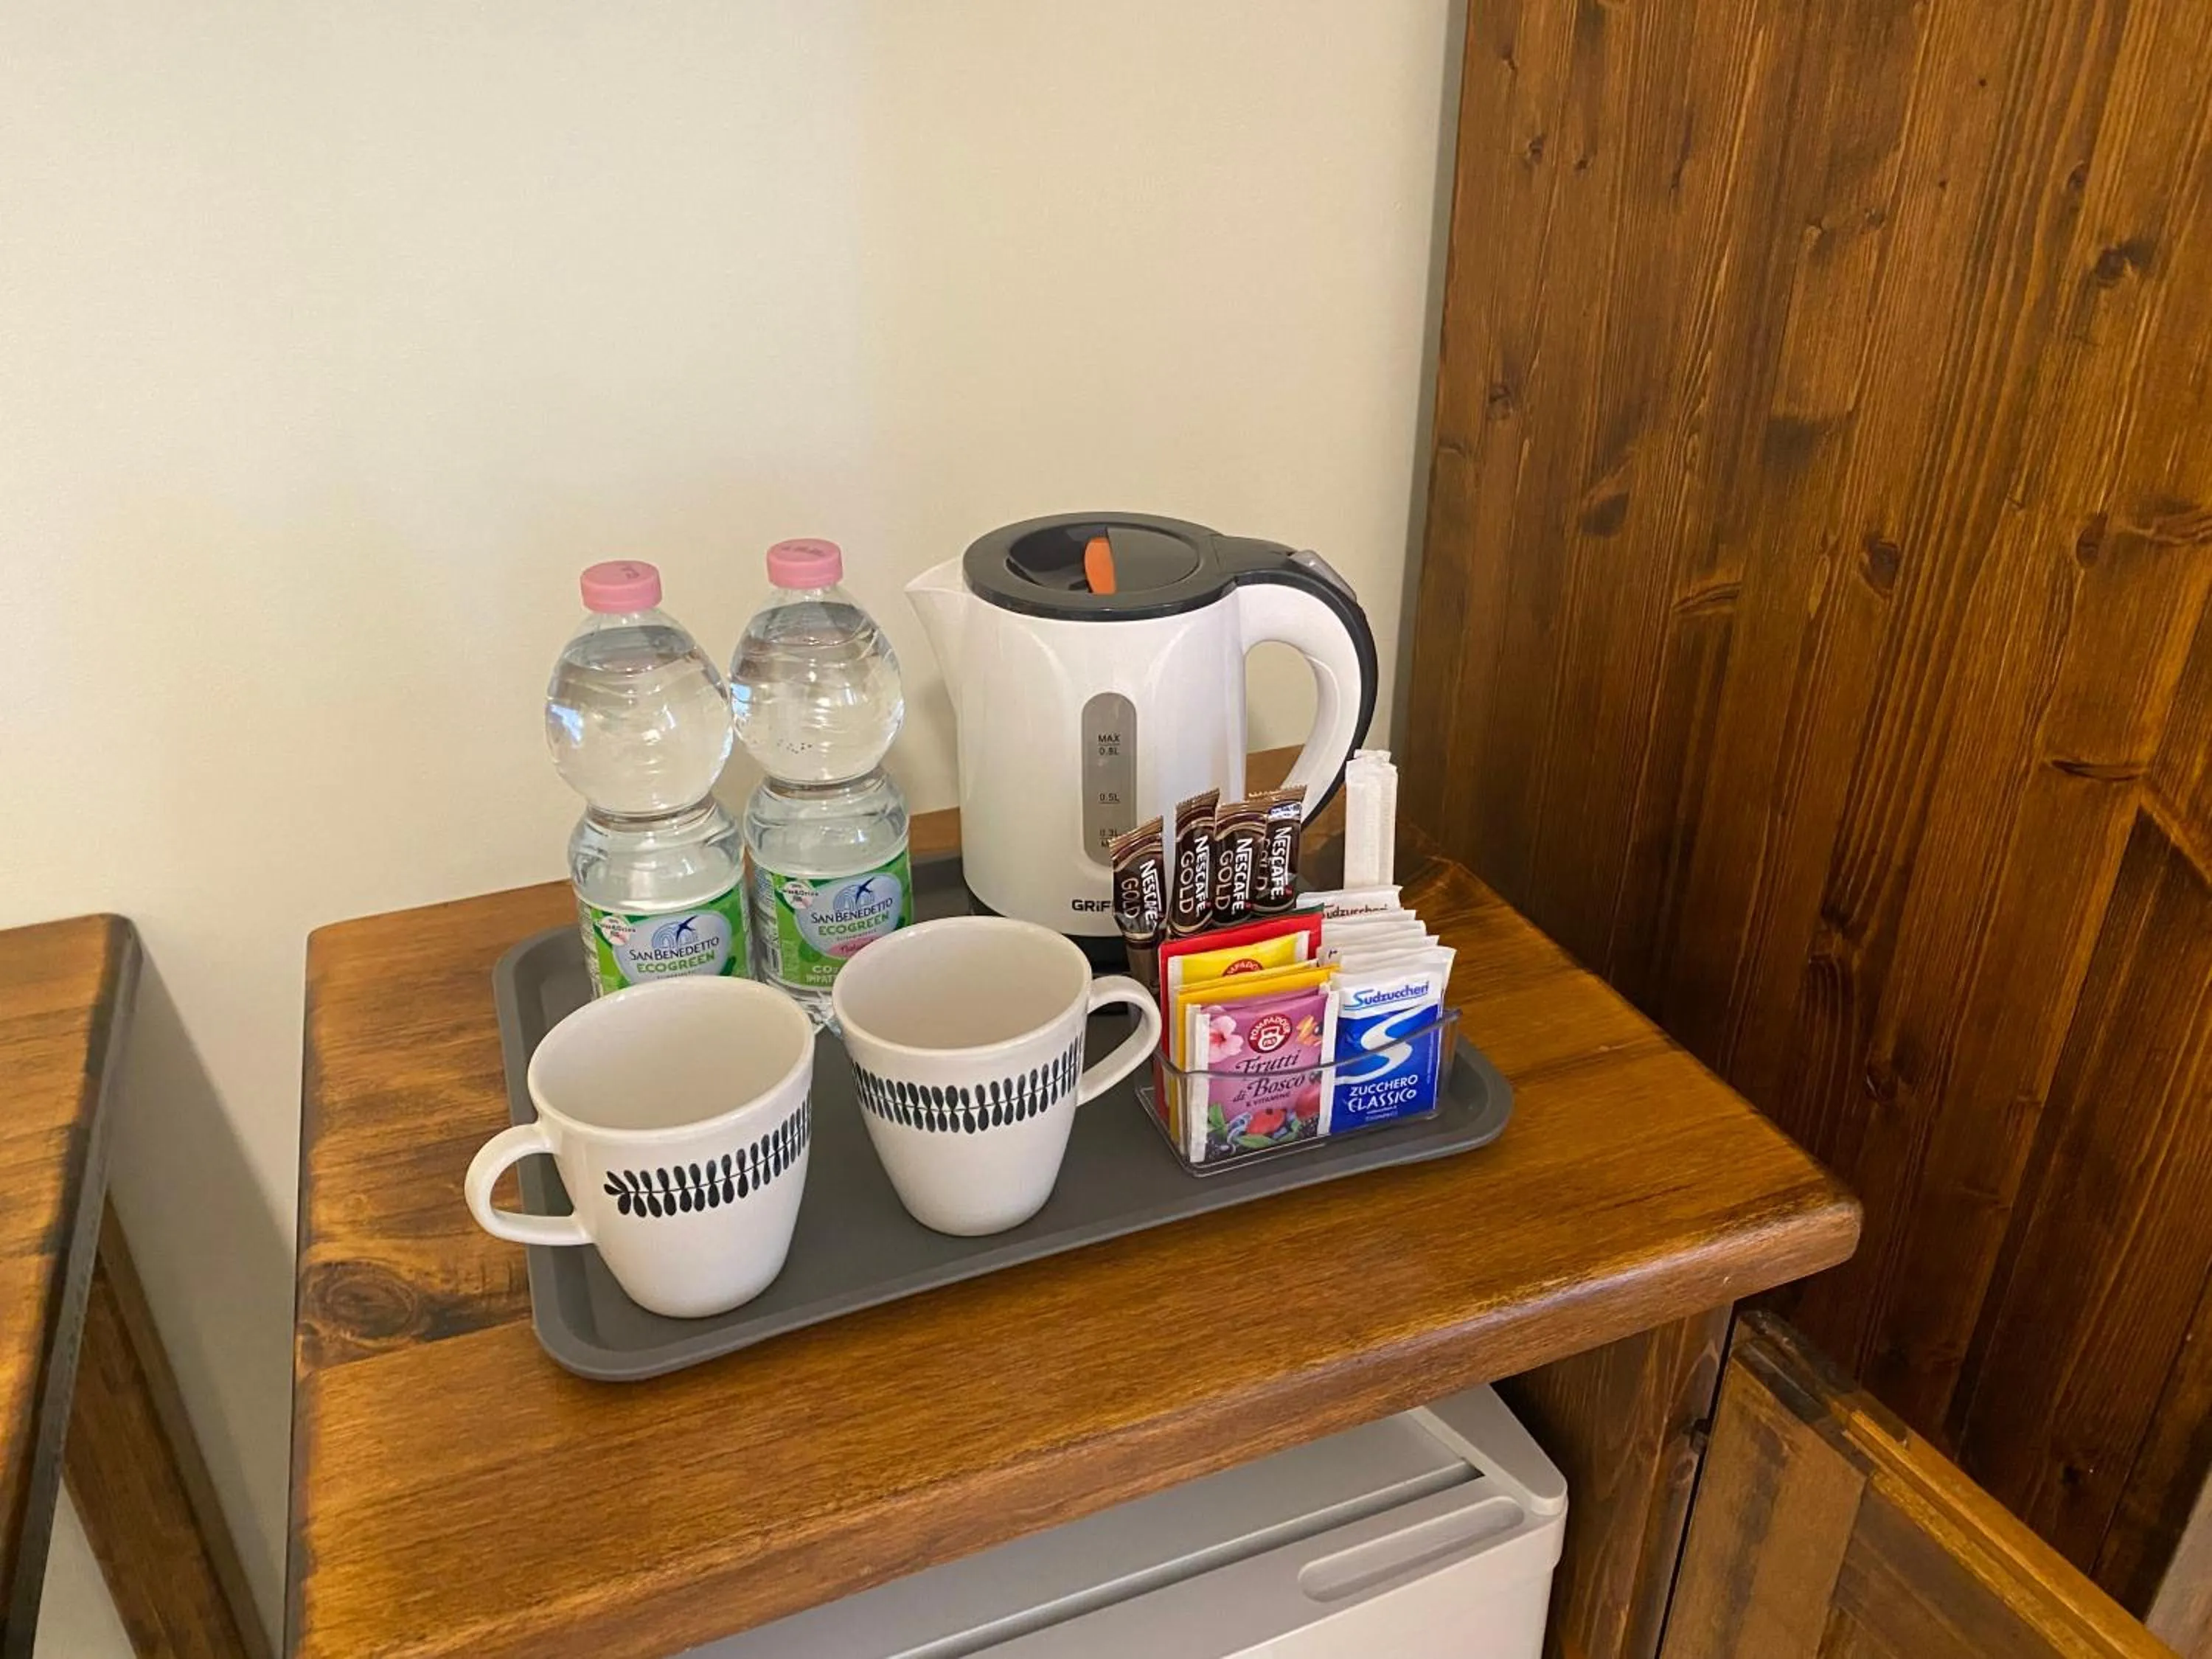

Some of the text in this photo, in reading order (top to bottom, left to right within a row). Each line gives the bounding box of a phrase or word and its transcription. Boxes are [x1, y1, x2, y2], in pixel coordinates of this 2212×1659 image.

[1098, 734, 1120, 742] MAX
[1180, 850, 1194, 914] GOLD
[1216, 850, 1234, 910] GOLD
[1121, 877, 1141, 919] GOLD
[818, 913, 890, 936] ECOGREEN
[636, 950, 715, 973] ECOGREEN
[1235, 1050, 1301, 1074] Frutti
[1247, 1076, 1305, 1097] Bosco
[1349, 1074, 1418, 1096] ZUCCHERO
[1348, 1088, 1416, 1113] CLASSICO
